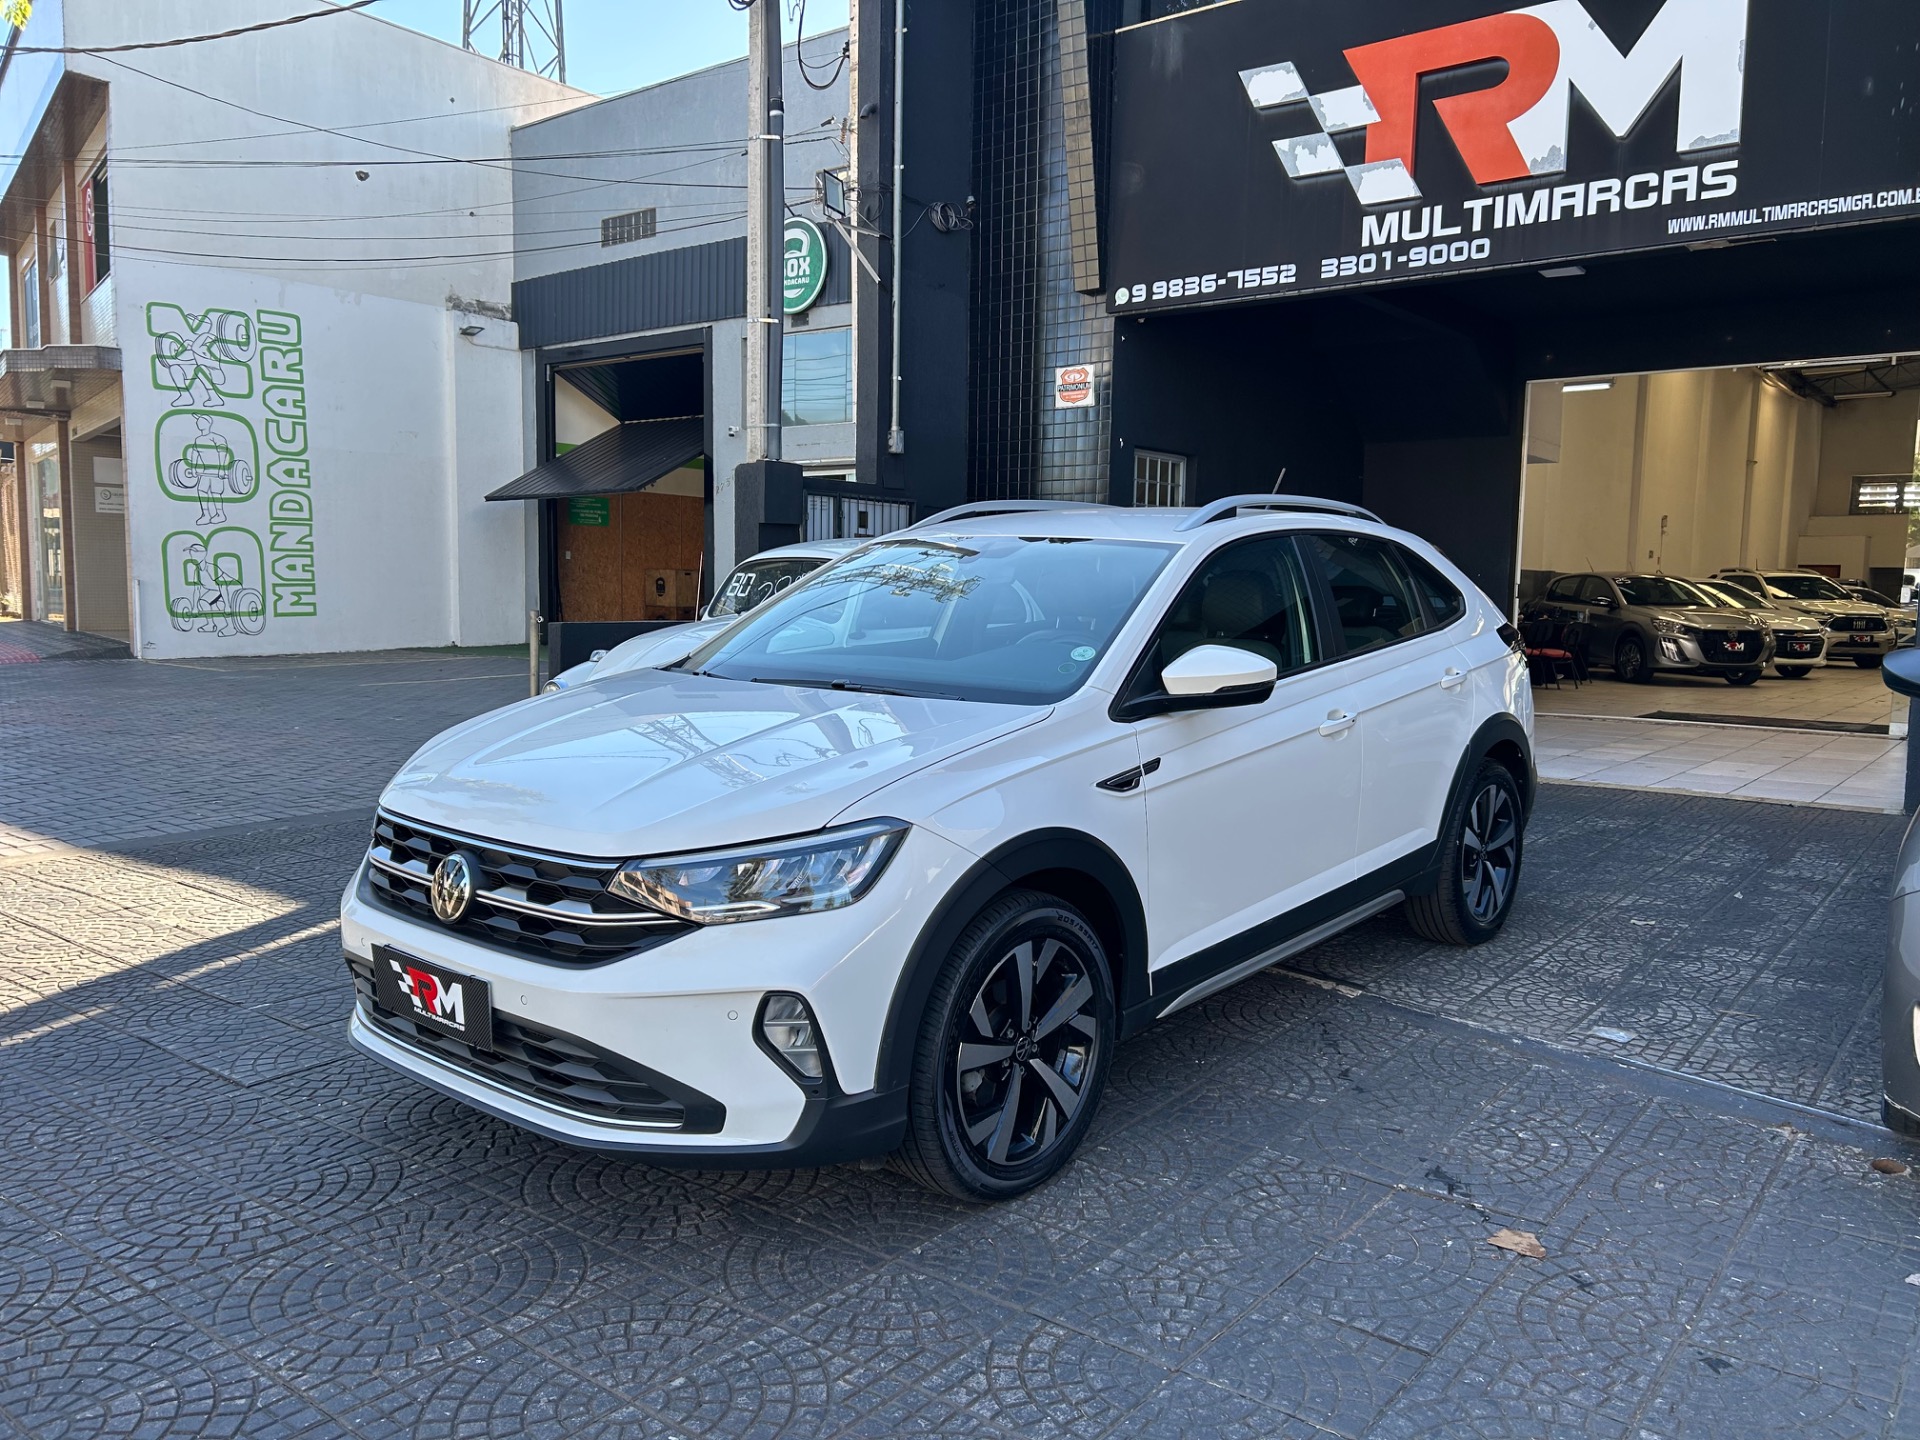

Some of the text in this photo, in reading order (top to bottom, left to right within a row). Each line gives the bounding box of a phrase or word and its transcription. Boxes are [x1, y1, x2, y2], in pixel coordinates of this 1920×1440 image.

[1361, 159, 1740, 248] MULTIMARCAS
[784, 257, 810, 277] OX
[1131, 237, 1491, 303] 9 9836-7552 3301-9000
[146, 301, 266, 618] BOX
[256, 308, 318, 618] MANDACARU
[727, 572, 756, 597] 80
[1614, 577, 1632, 585] 25
[405, 965, 466, 1025] RM
[413, 1006, 466, 1032] MULTIMARCAS
